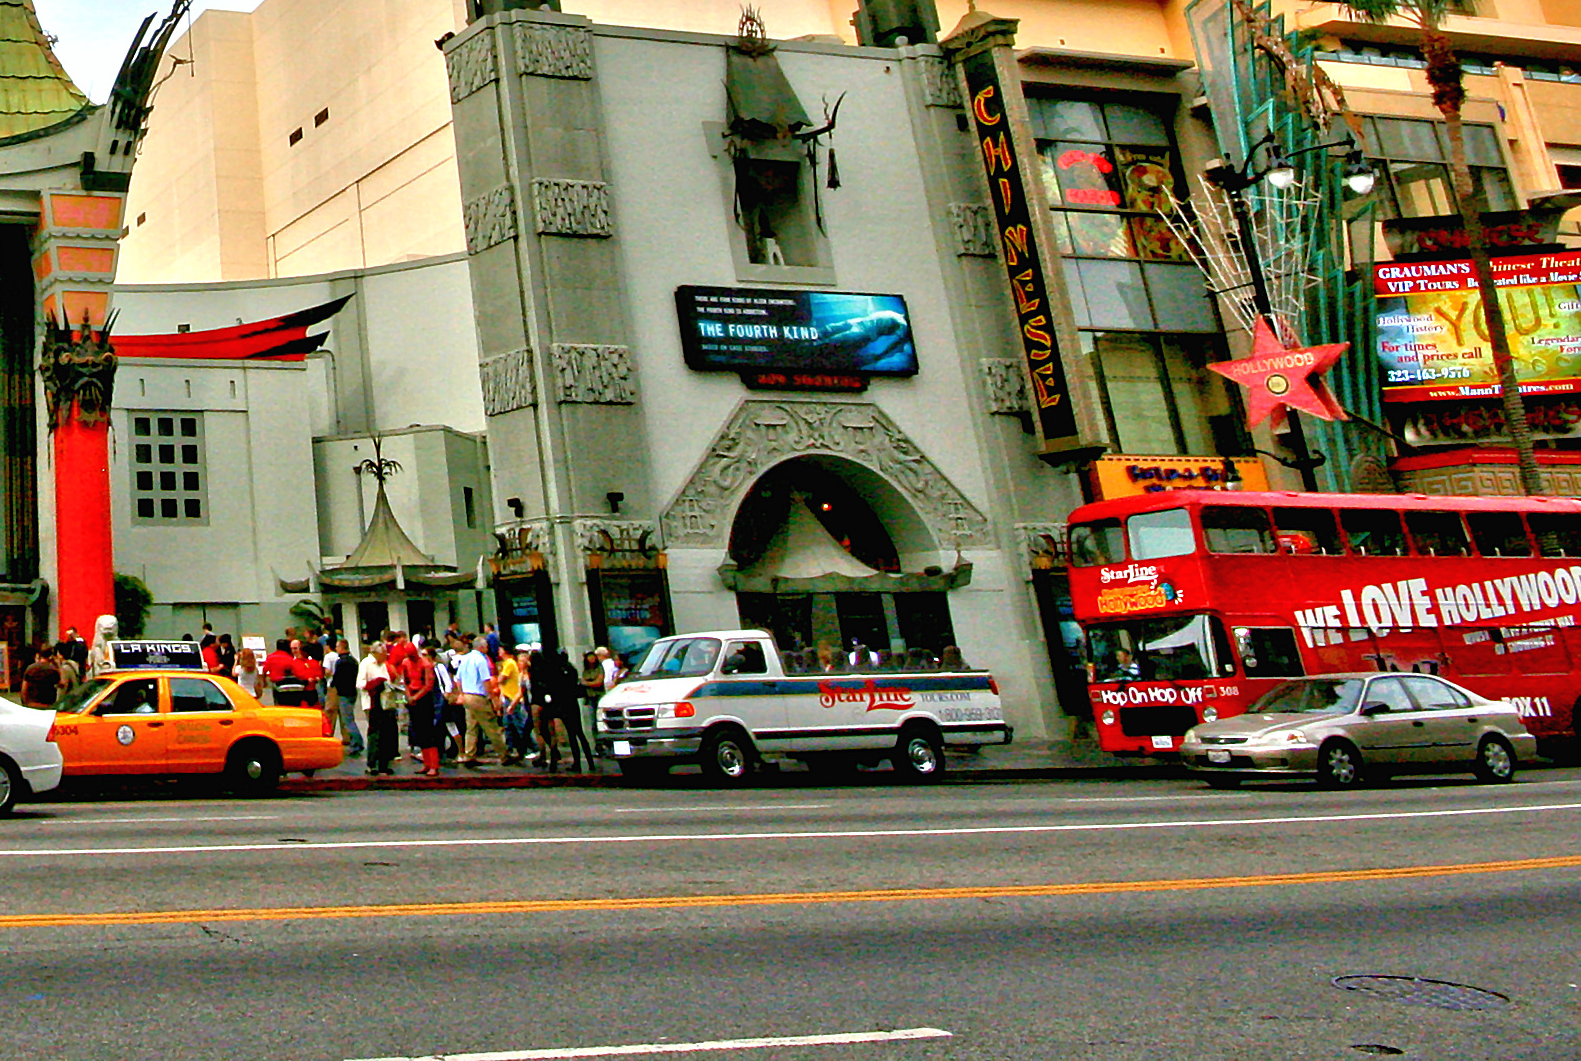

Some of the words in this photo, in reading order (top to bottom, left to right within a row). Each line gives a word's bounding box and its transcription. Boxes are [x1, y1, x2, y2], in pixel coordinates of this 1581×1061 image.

[973, 84, 1061, 409] CHINESE
[1377, 262, 1471, 280] GRAUMAN'S
[1489, 260, 1535, 272] hinese
[1387, 281, 1414, 293] VIP
[698, 322, 725, 337] THE
[728, 323, 778, 339] FOURTH
[783, 325, 819, 340] KIND
[1381, 341, 1401, 353] For
[1404, 340, 1438, 352] times
[1397, 352, 1419, 364] and
[1422, 350, 1459, 365] prices
[1461, 346, 1483, 359] call
[1231, 351, 1314, 378] HOLLYWOOD
[1428, 382, 1575, 398] www.MannTtres.com
[1294, 605, 1344, 648] WE
[1340, 578, 1438, 642] LOVE
[120, 643, 142, 653] LA
[145, 643, 192, 653] KINGS
[1101, 689, 1127, 706] Hop
[1128, 686, 1148, 704] On
[1147, 687, 1177, 703] Hop
[1180, 687, 1203, 704] Off
[1219, 686, 1240, 697] 308
[1535, 696, 1552, 717] 11
